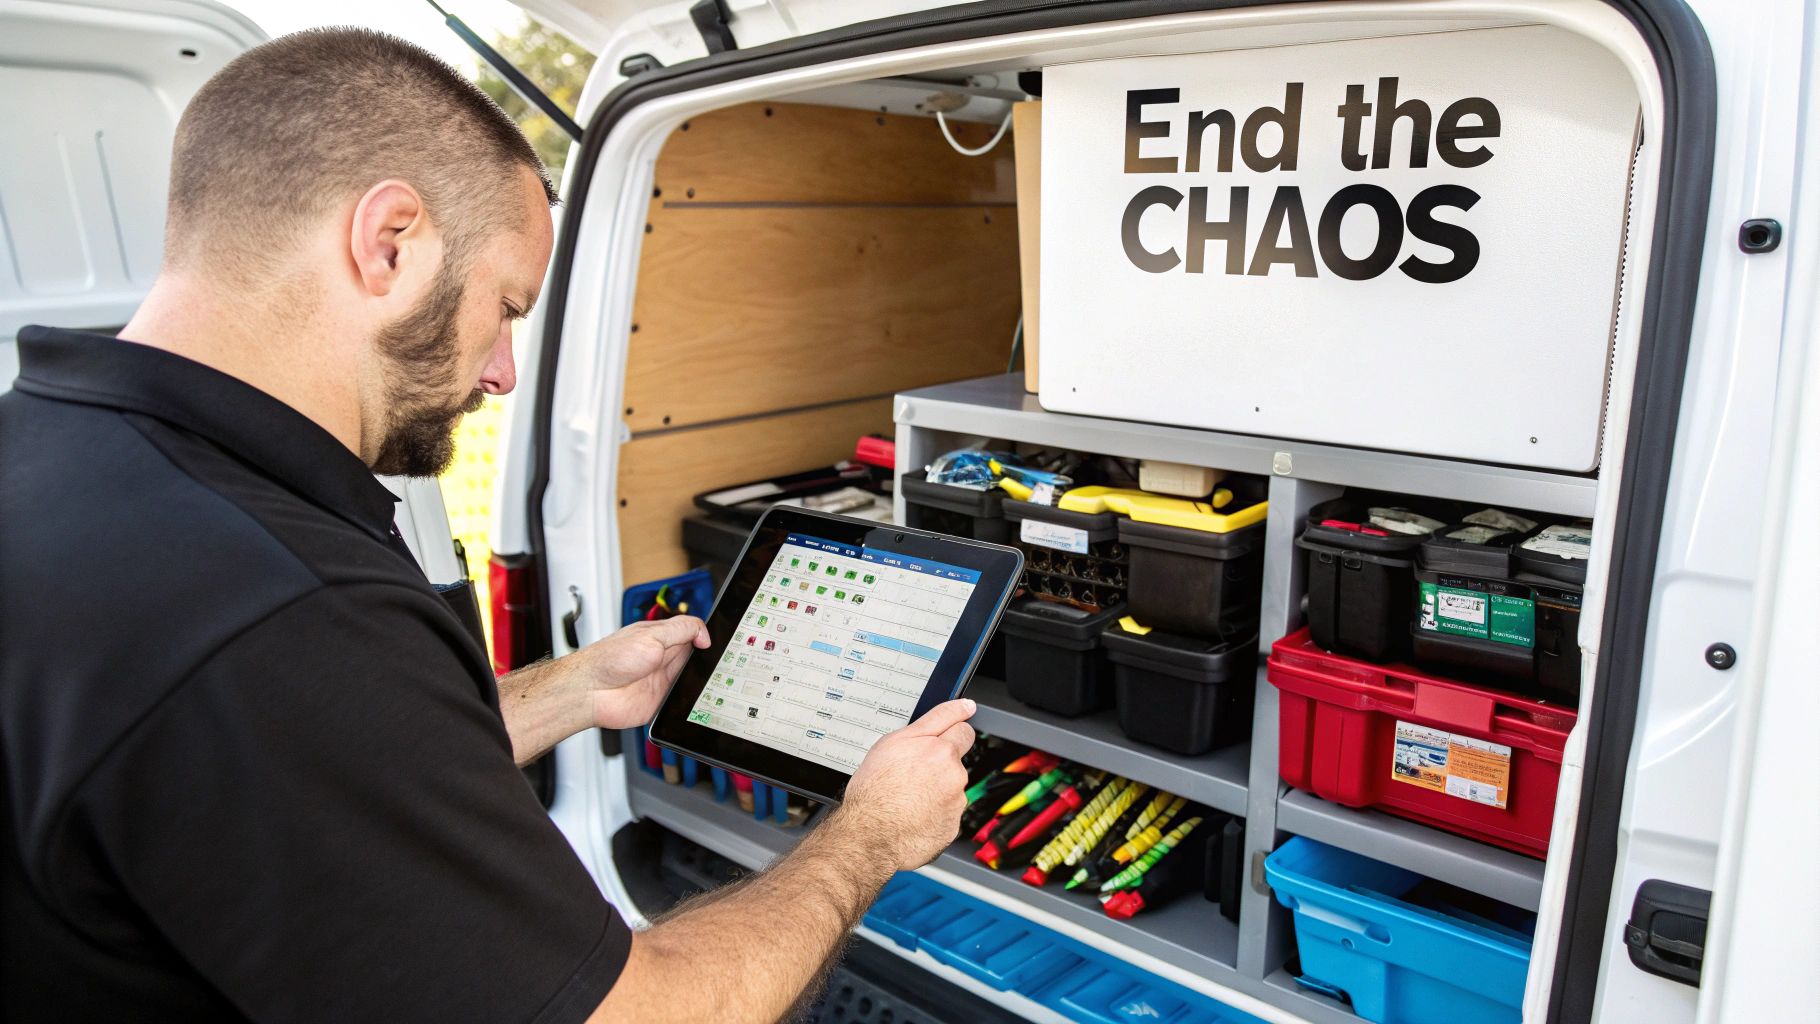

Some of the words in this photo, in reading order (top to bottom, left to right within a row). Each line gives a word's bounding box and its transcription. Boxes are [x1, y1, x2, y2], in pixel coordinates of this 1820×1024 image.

[1123, 82, 1305, 174] End
[1337, 77, 1502, 172] the
[1120, 183, 1482, 284] CHAOS
